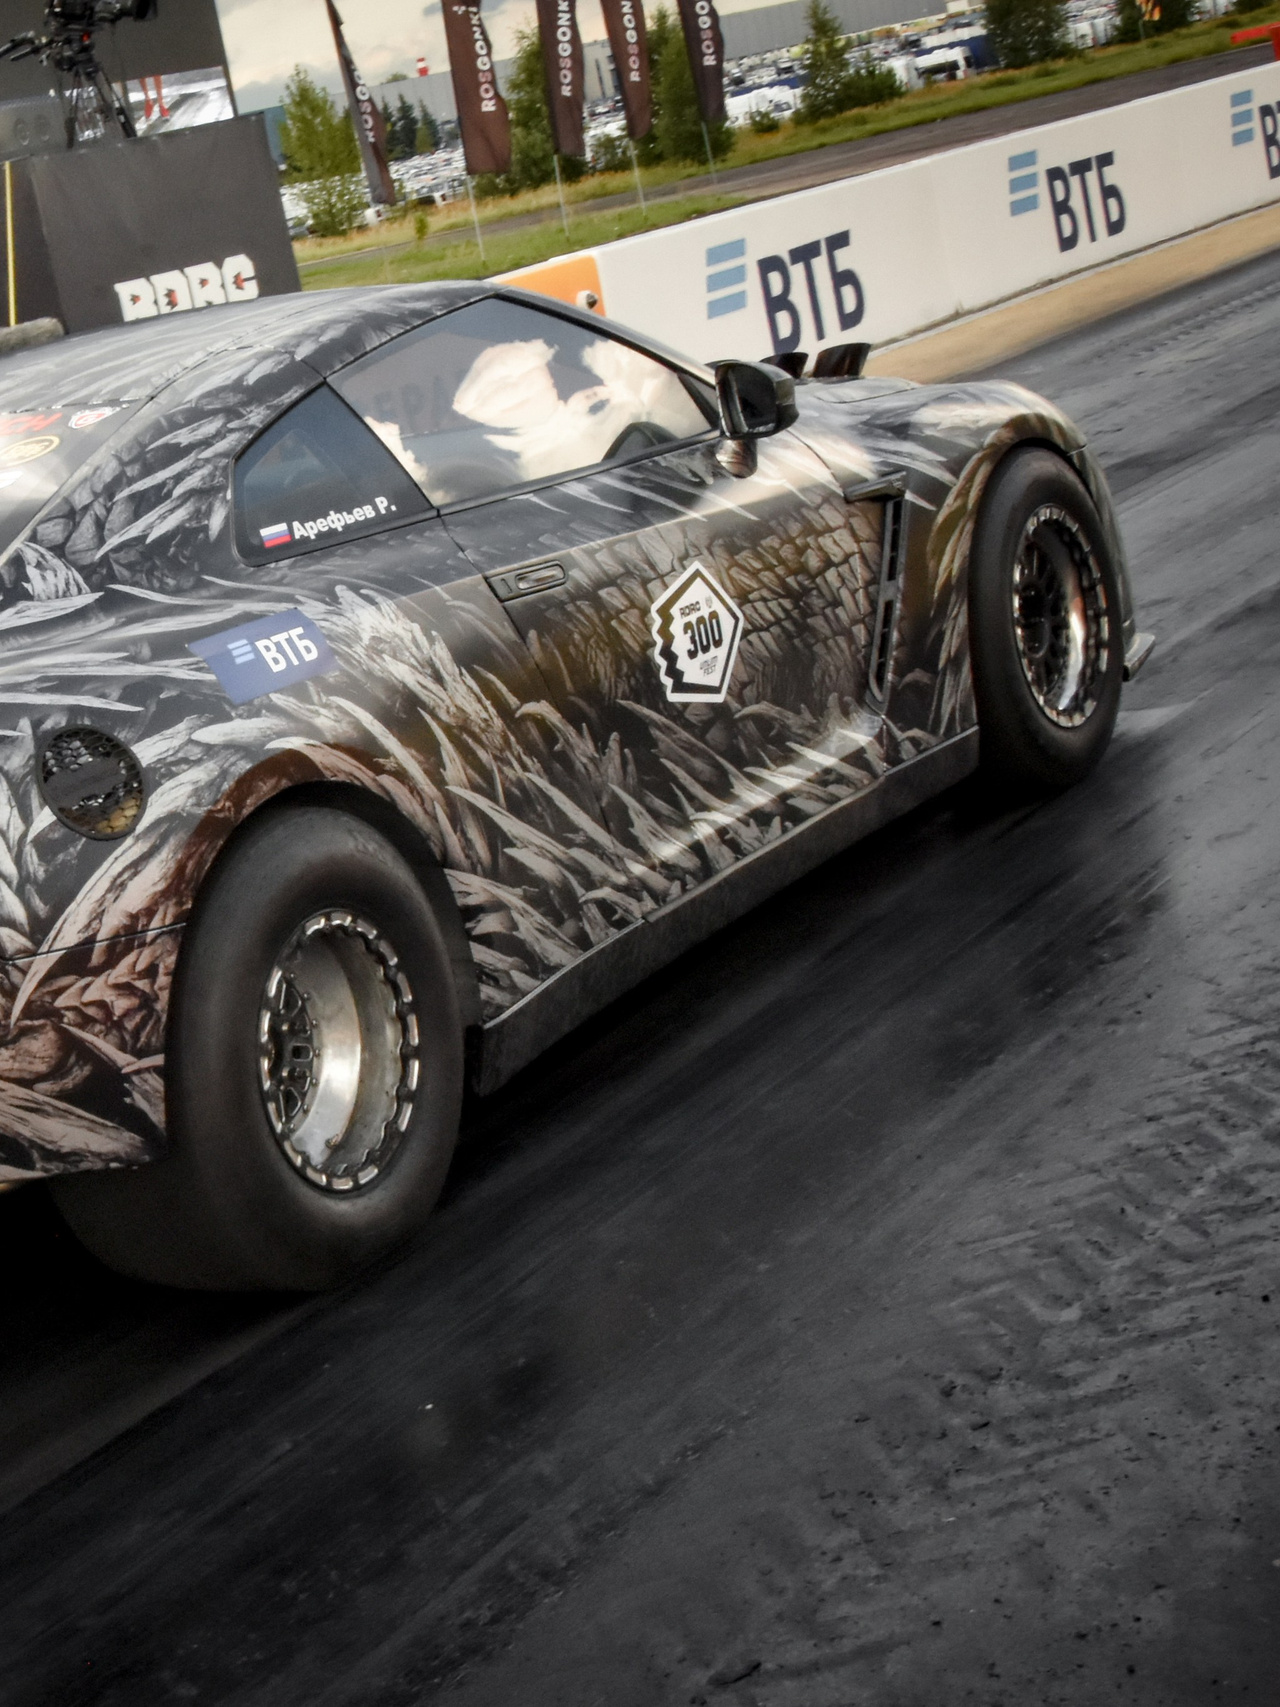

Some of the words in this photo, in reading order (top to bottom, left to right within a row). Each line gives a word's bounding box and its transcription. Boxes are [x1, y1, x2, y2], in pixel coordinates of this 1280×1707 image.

[468, 6, 497, 112] ROSGONKI
[1046, 151, 1127, 253] ВТБ
[757, 229, 865, 354] ВТБ
[292, 504, 376, 540] Арефьев
[374, 496, 397, 515] Р.
[255, 626, 318, 673] ВТБ
[683, 610, 723, 660] 300
